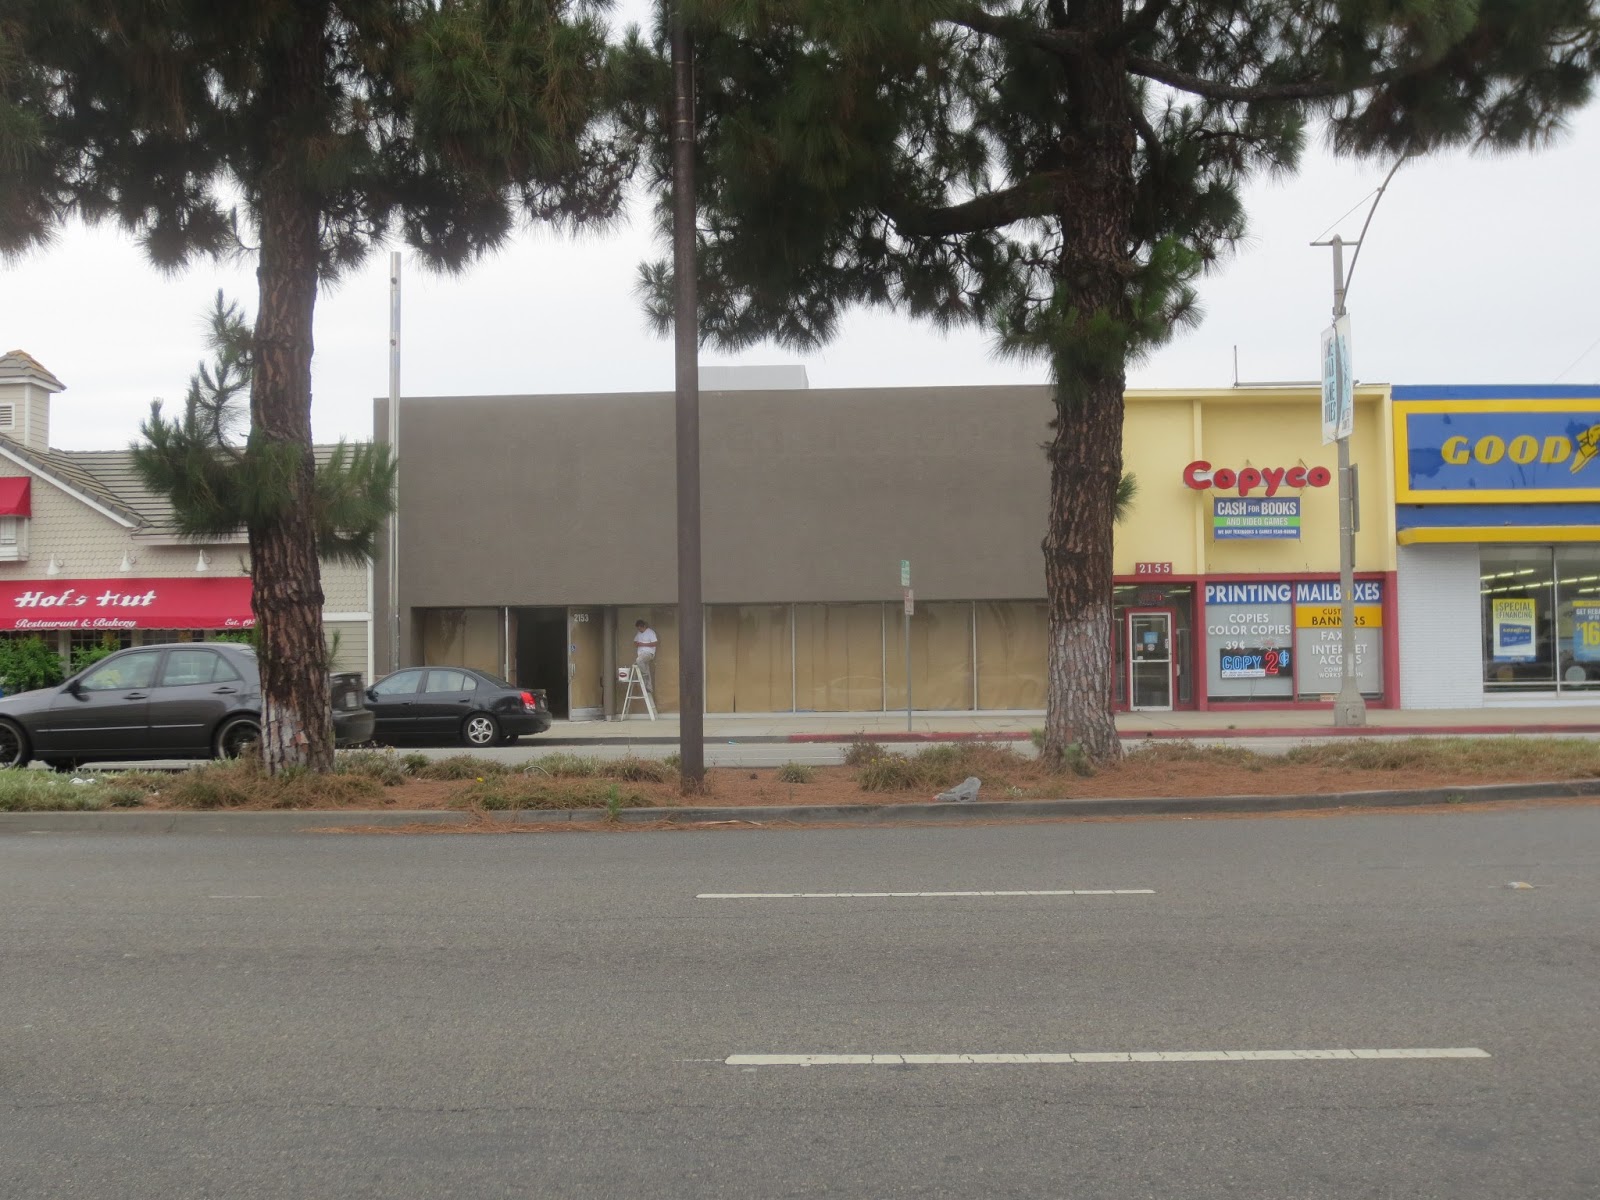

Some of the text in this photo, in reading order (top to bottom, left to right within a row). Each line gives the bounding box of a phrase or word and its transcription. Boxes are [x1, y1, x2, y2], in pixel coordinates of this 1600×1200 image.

[1441, 435, 1572, 465] GOOD
[1183, 460, 1331, 497] Copyco
[1217, 502, 1297, 515] CASH FOR BOOKS
[1226, 517, 1288, 526] AND VIDEO GAMES
[1139, 563, 1171, 574] 2155
[1205, 584, 1291, 603] PRINTING
[1296, 583, 1380, 601] MAILBXES
[96, 590, 157, 607] Hut
[1499, 601, 1532, 611] SPECIAL
[573, 613, 589, 622] 2153
[1228, 613, 1269, 624] COPIES
[1499, 611, 1533, 619] FINANCING
[15, 617, 137, 628] Restaurant & Bakery
[1312, 616, 1366, 626] BANNRS
[1207, 625, 1291, 636] COLOR COPIES
[1225, 640, 1245, 650] 39¢
[1312, 644, 1368, 654] INTERET
[1221, 655, 1262, 671] COPY
[1319, 655, 1363, 665] ACCS
